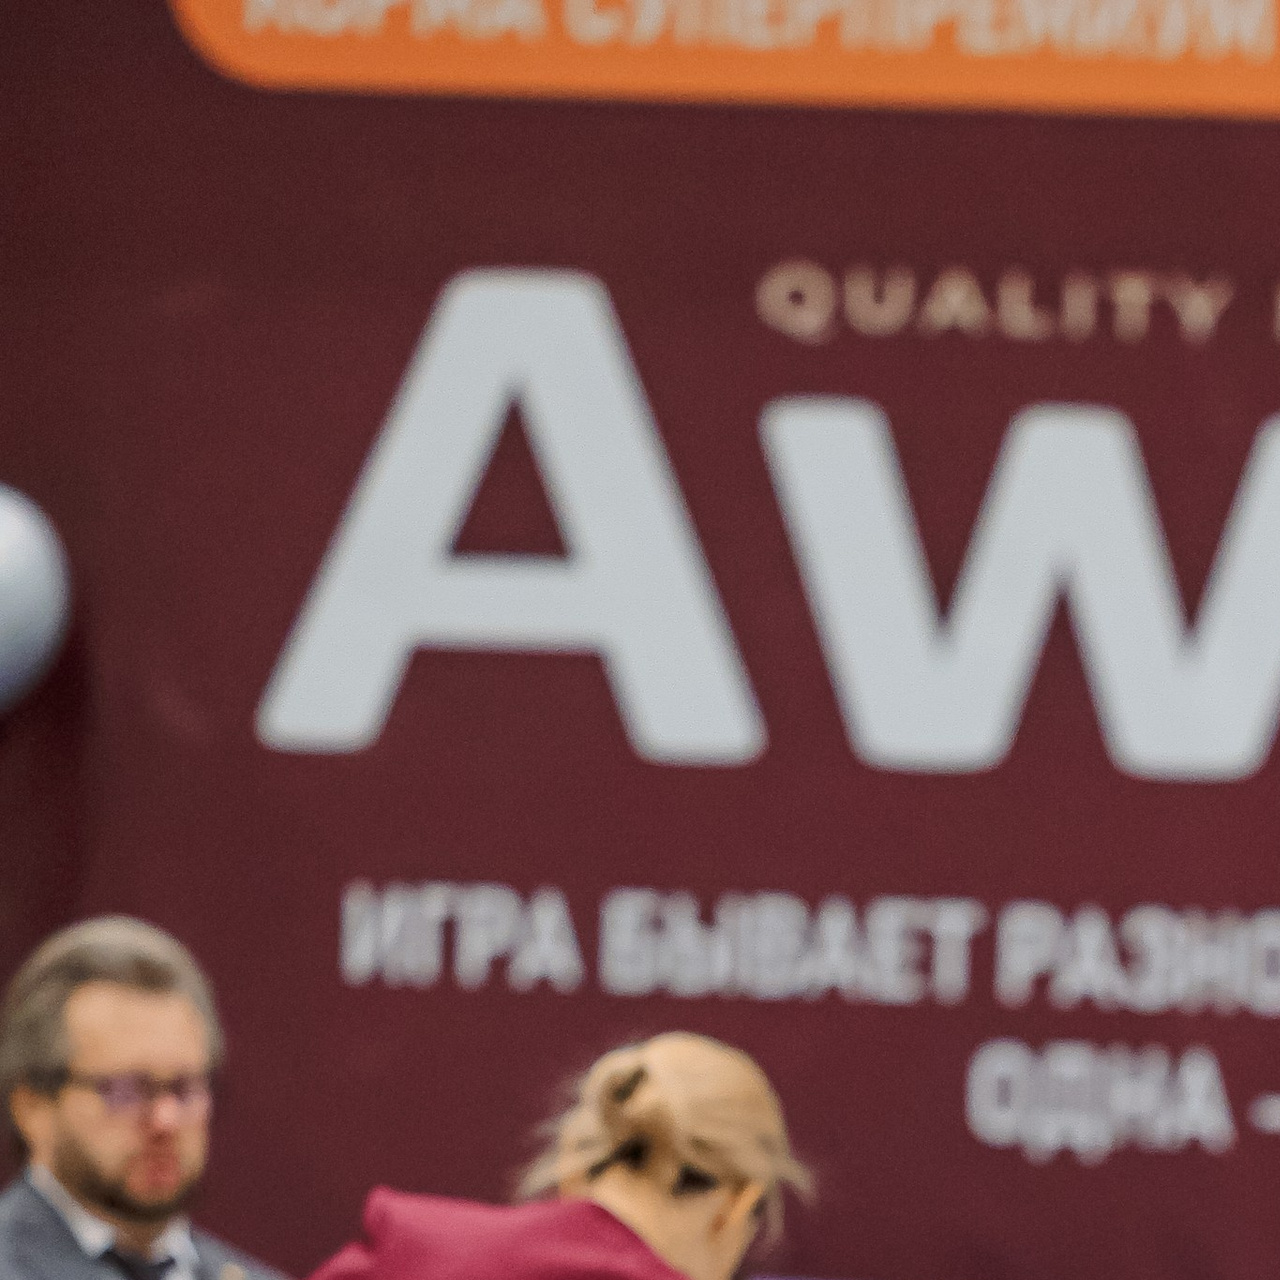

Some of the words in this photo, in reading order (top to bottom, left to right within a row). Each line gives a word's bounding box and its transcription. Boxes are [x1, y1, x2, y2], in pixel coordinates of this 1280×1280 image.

[755, 258, 1235, 344] QUALITY
[340, 877, 584, 990] ИГРА
[601, 885, 986, 1003] БЫВАЕТ
[963, 1037, 1236, 1161] ОДНА
